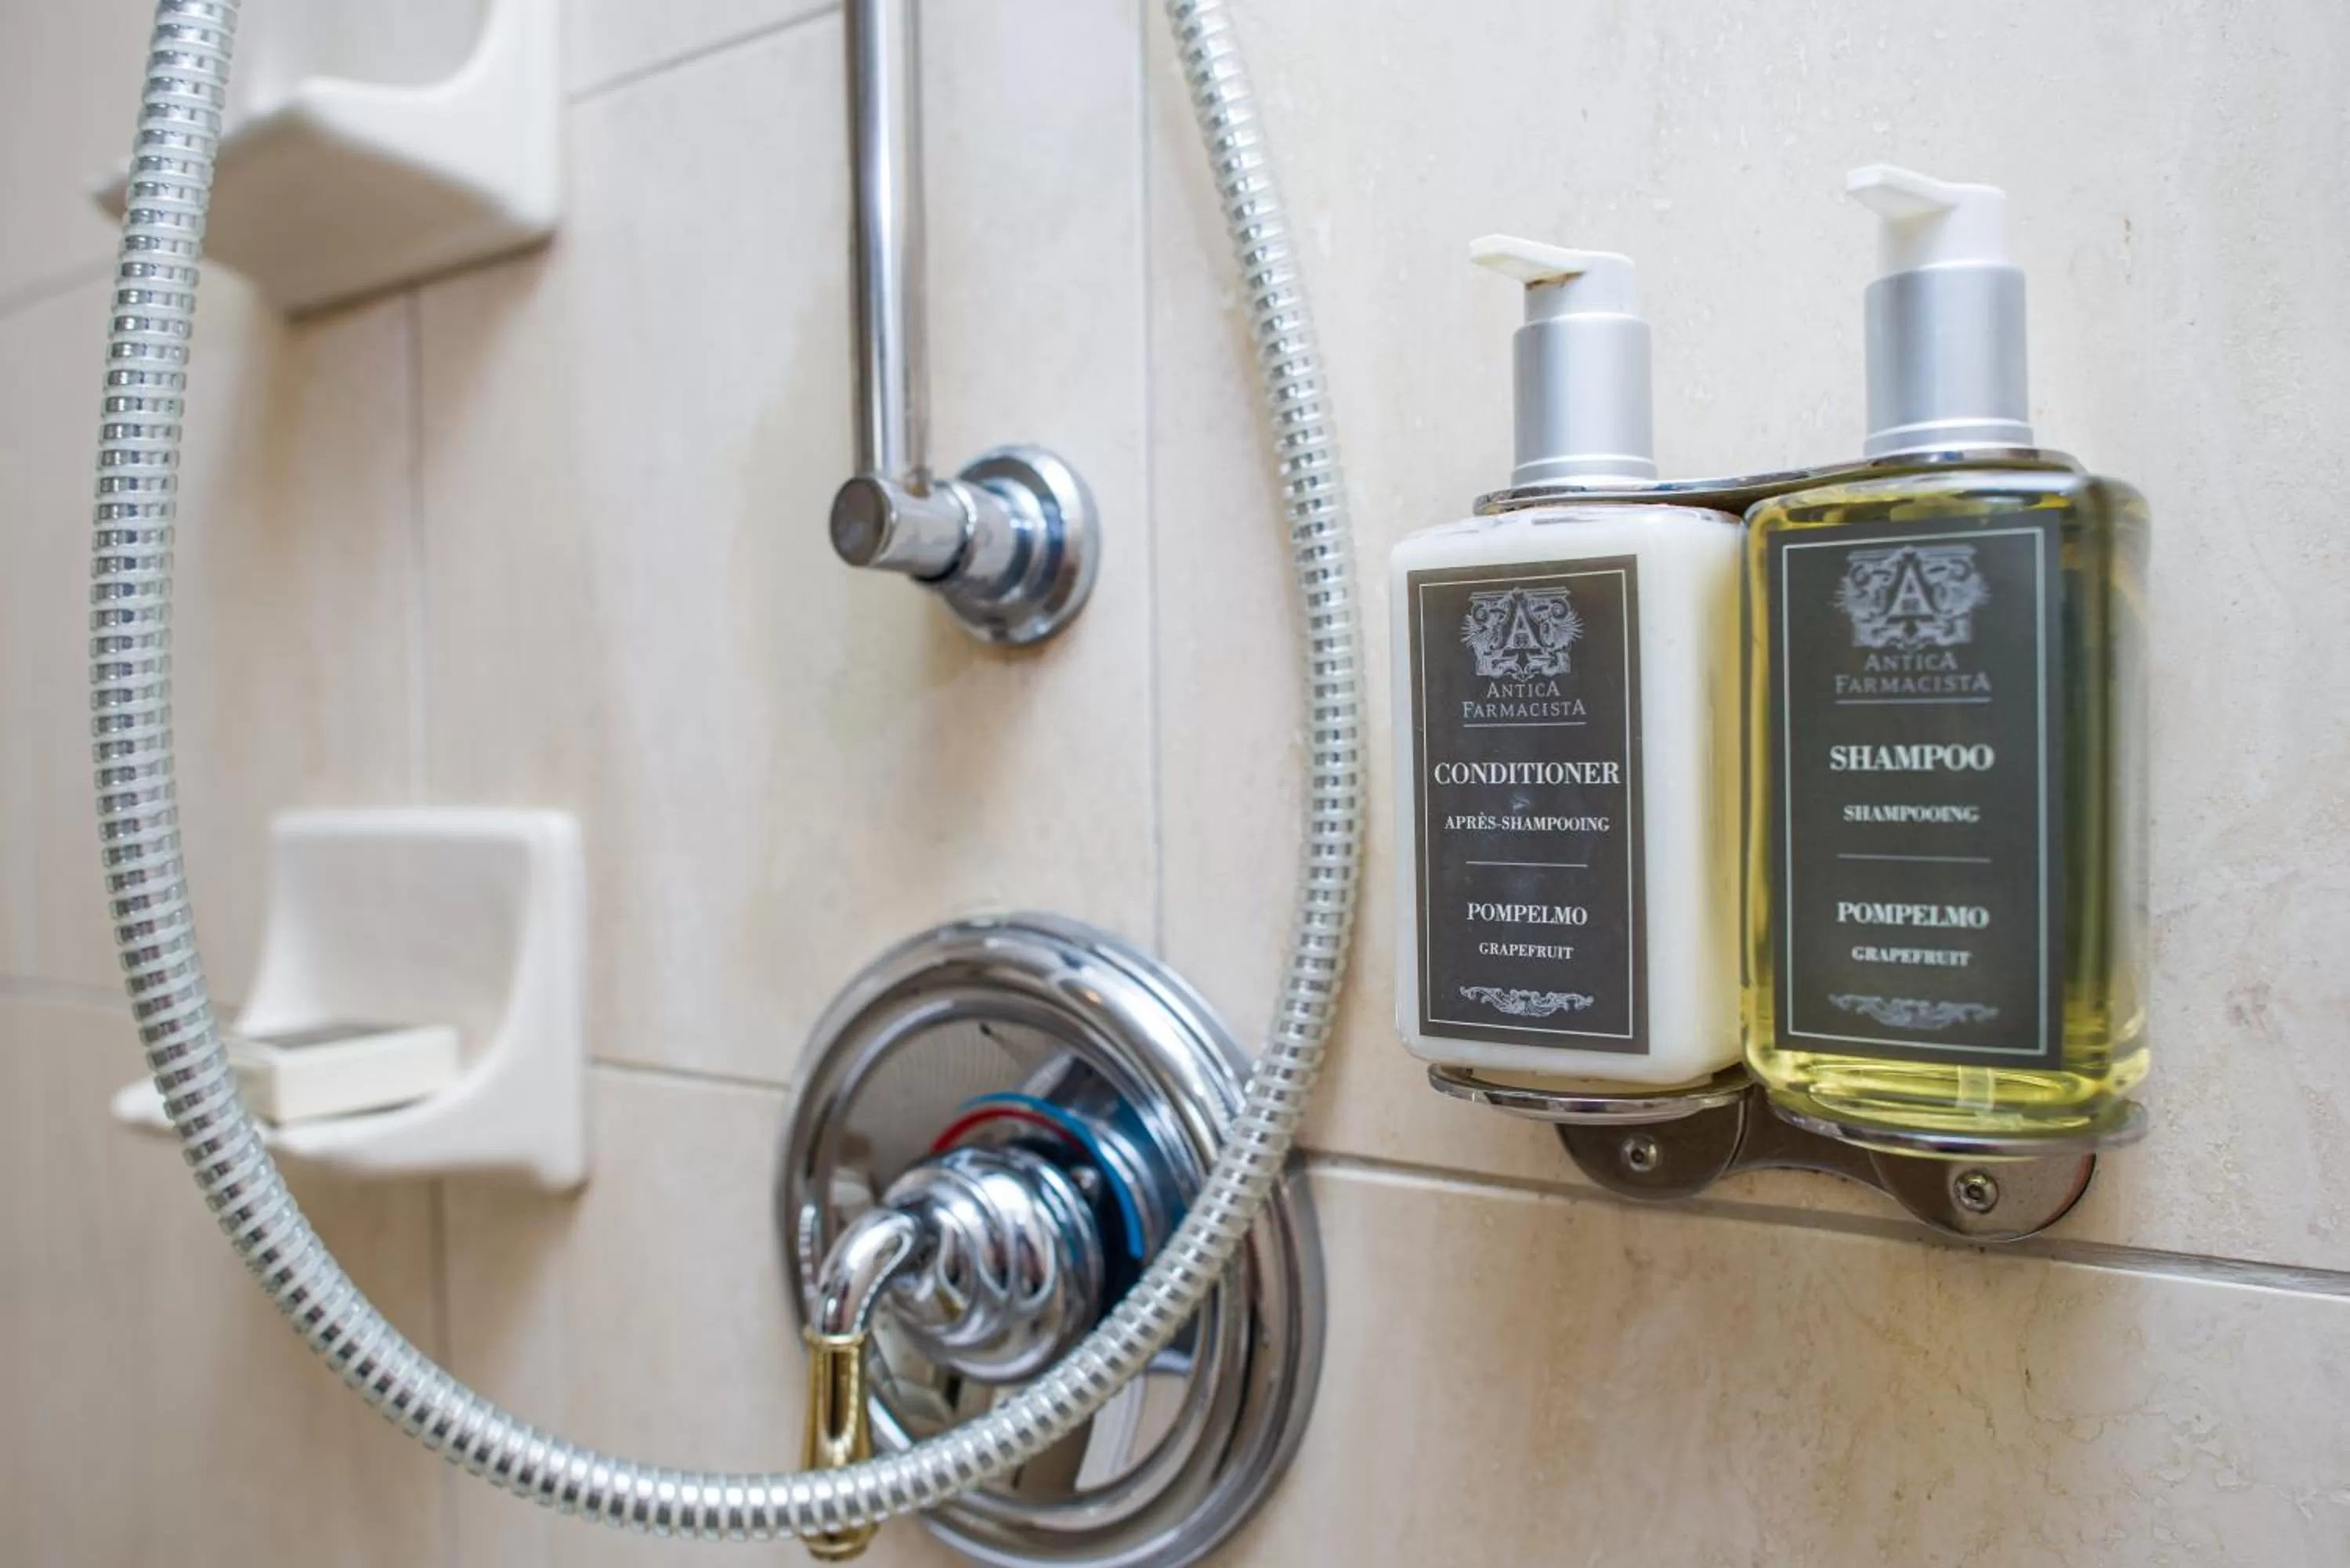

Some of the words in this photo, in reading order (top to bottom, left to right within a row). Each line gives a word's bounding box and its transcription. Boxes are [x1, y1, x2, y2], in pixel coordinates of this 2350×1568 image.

[1864, 651, 1958, 671] ANTICA
[1486, 680, 1562, 699] ANTICA
[1835, 671, 1992, 694] FARMACISTA
[1462, 699, 1587, 718] FARMACISTA
[1829, 744, 1995, 771] SHAMPOO
[1434, 761, 1622, 784] CONDITIONER
[1444, 811, 1611, 832] APRÈS-SHAMPOOING
[1842, 804, 1980, 823] SHAMPOOING
[1466, 902, 1589, 926] POMPELMO
[1836, 901, 1990, 929] POMPELMO
[1478, 942, 1574, 960] GRAPEFRUIT
[1851, 945, 1973, 967] GRAPEFRUIT
